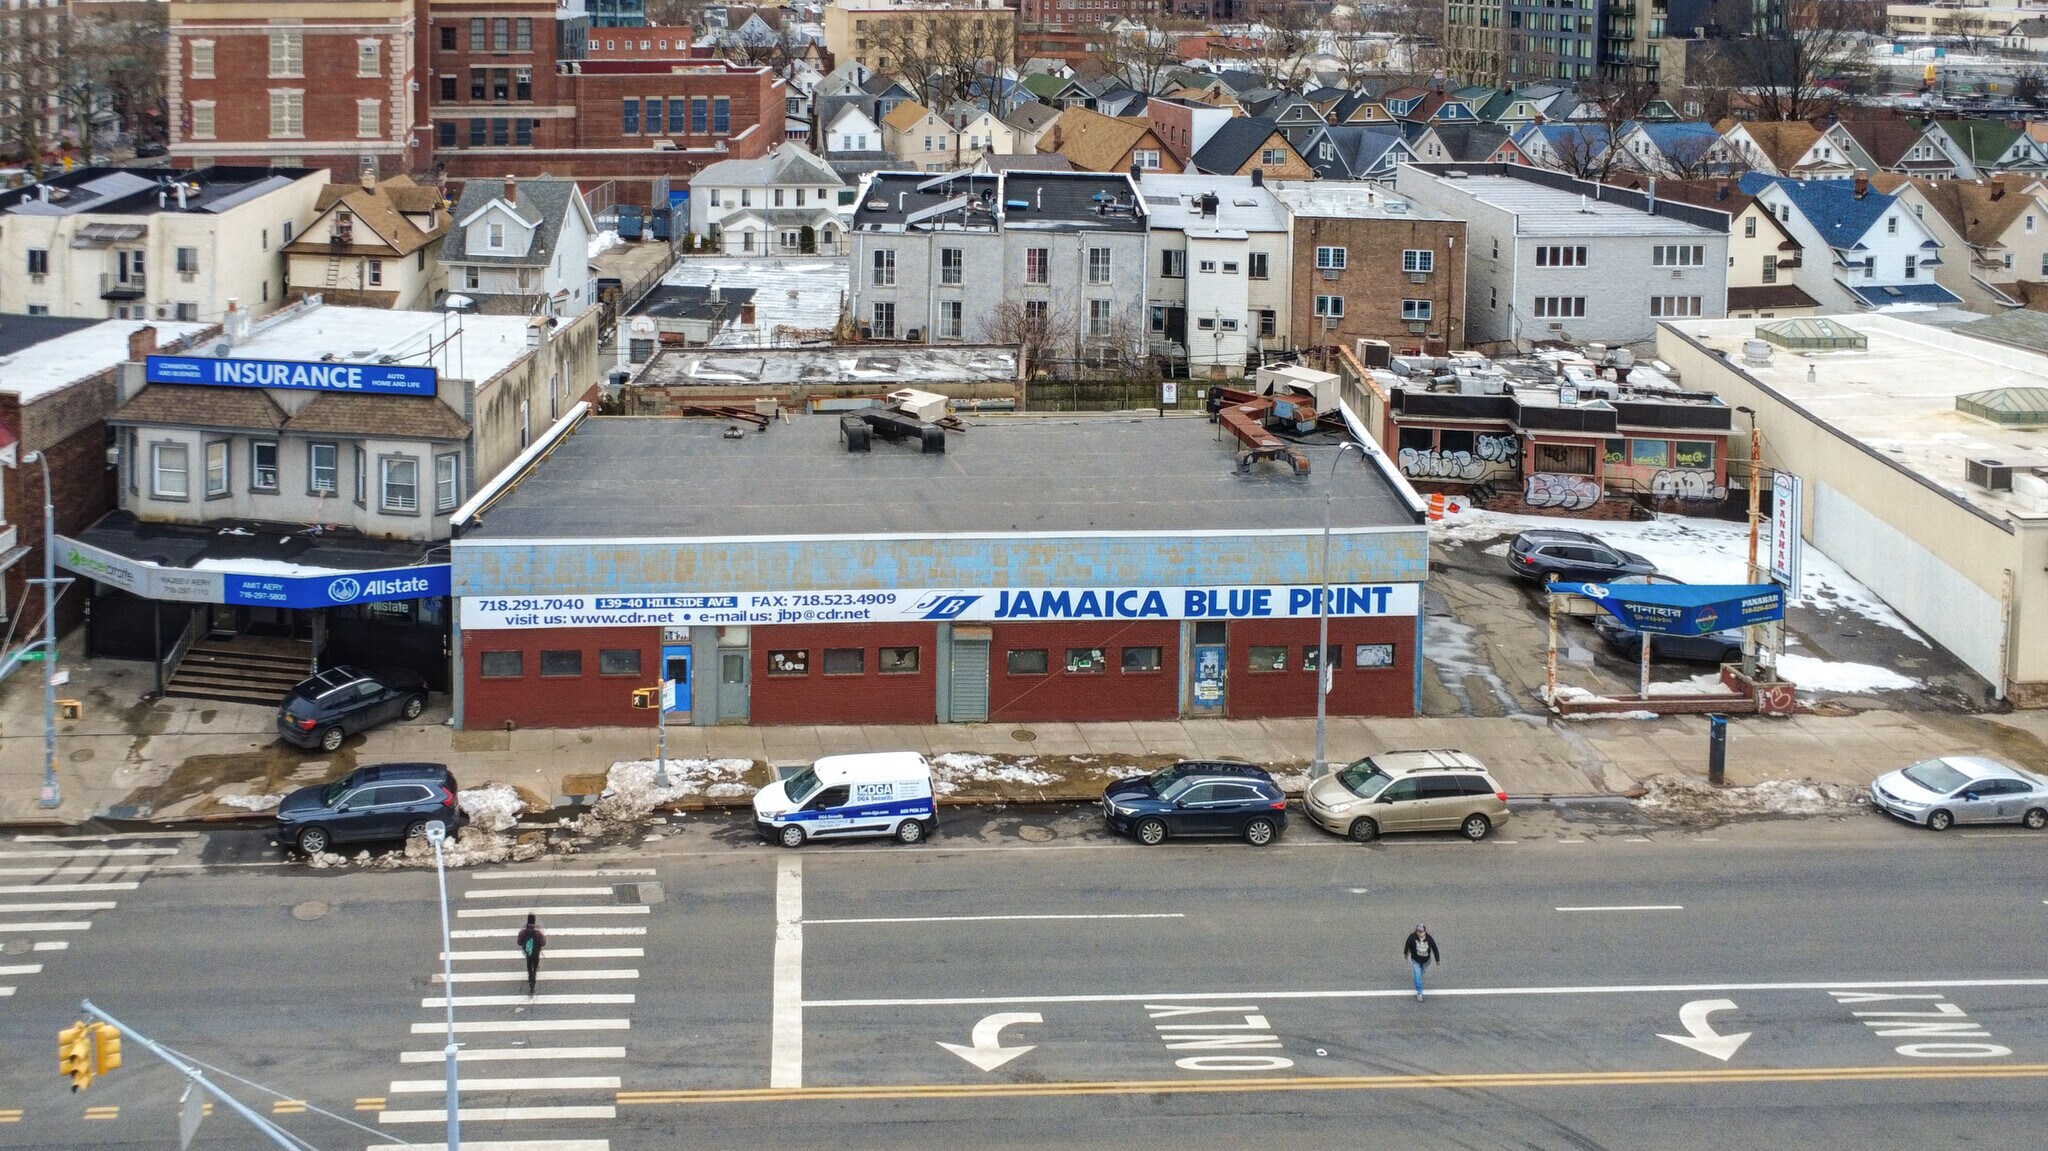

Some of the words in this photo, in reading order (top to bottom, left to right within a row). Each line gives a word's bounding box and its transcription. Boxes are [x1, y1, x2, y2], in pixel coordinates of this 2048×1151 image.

[214, 361, 363, 389] INSURANCE
[407, 381, 420, 389] LIFE
[1777, 498, 1786, 570] PANAHAR
[242, 581, 261, 590] AMIT
[262, 582, 284, 591] AERY
[363, 577, 429, 596] Allstate
[239, 591, 287, 601] 718-297-5800
[479, 598, 584, 612] 718.291.7040
[600, 598, 643, 609] 139-40
[646, 597, 704, 608] HILLSIDE
[707, 596, 735, 607] AVE.
[751, 595, 788, 607] FAX:
[792, 593, 896, 606] 718.523.4909
[994, 590, 1169, 618] JAMAICA
[1184, 589, 1273, 618] BLUE
[1288, 586, 1394, 615] PRINT
[1741, 594, 1779, 607] PANAHAR
[367, 601, 409, 613] Allstate
[505, 613, 539, 626] visit
[543, 614, 567, 625] us:
[570, 611, 675, 625] www.cdr.net
[699, 610, 748, 622] e-mail
[749, 611, 772, 621] us:
[776, 608, 870, 623] jbp@cdr.net
[867, 784, 893, 796] DGA
[1827, 991, 2013, 1058] ONLY
[1143, 1004, 1295, 1071] ONLY
